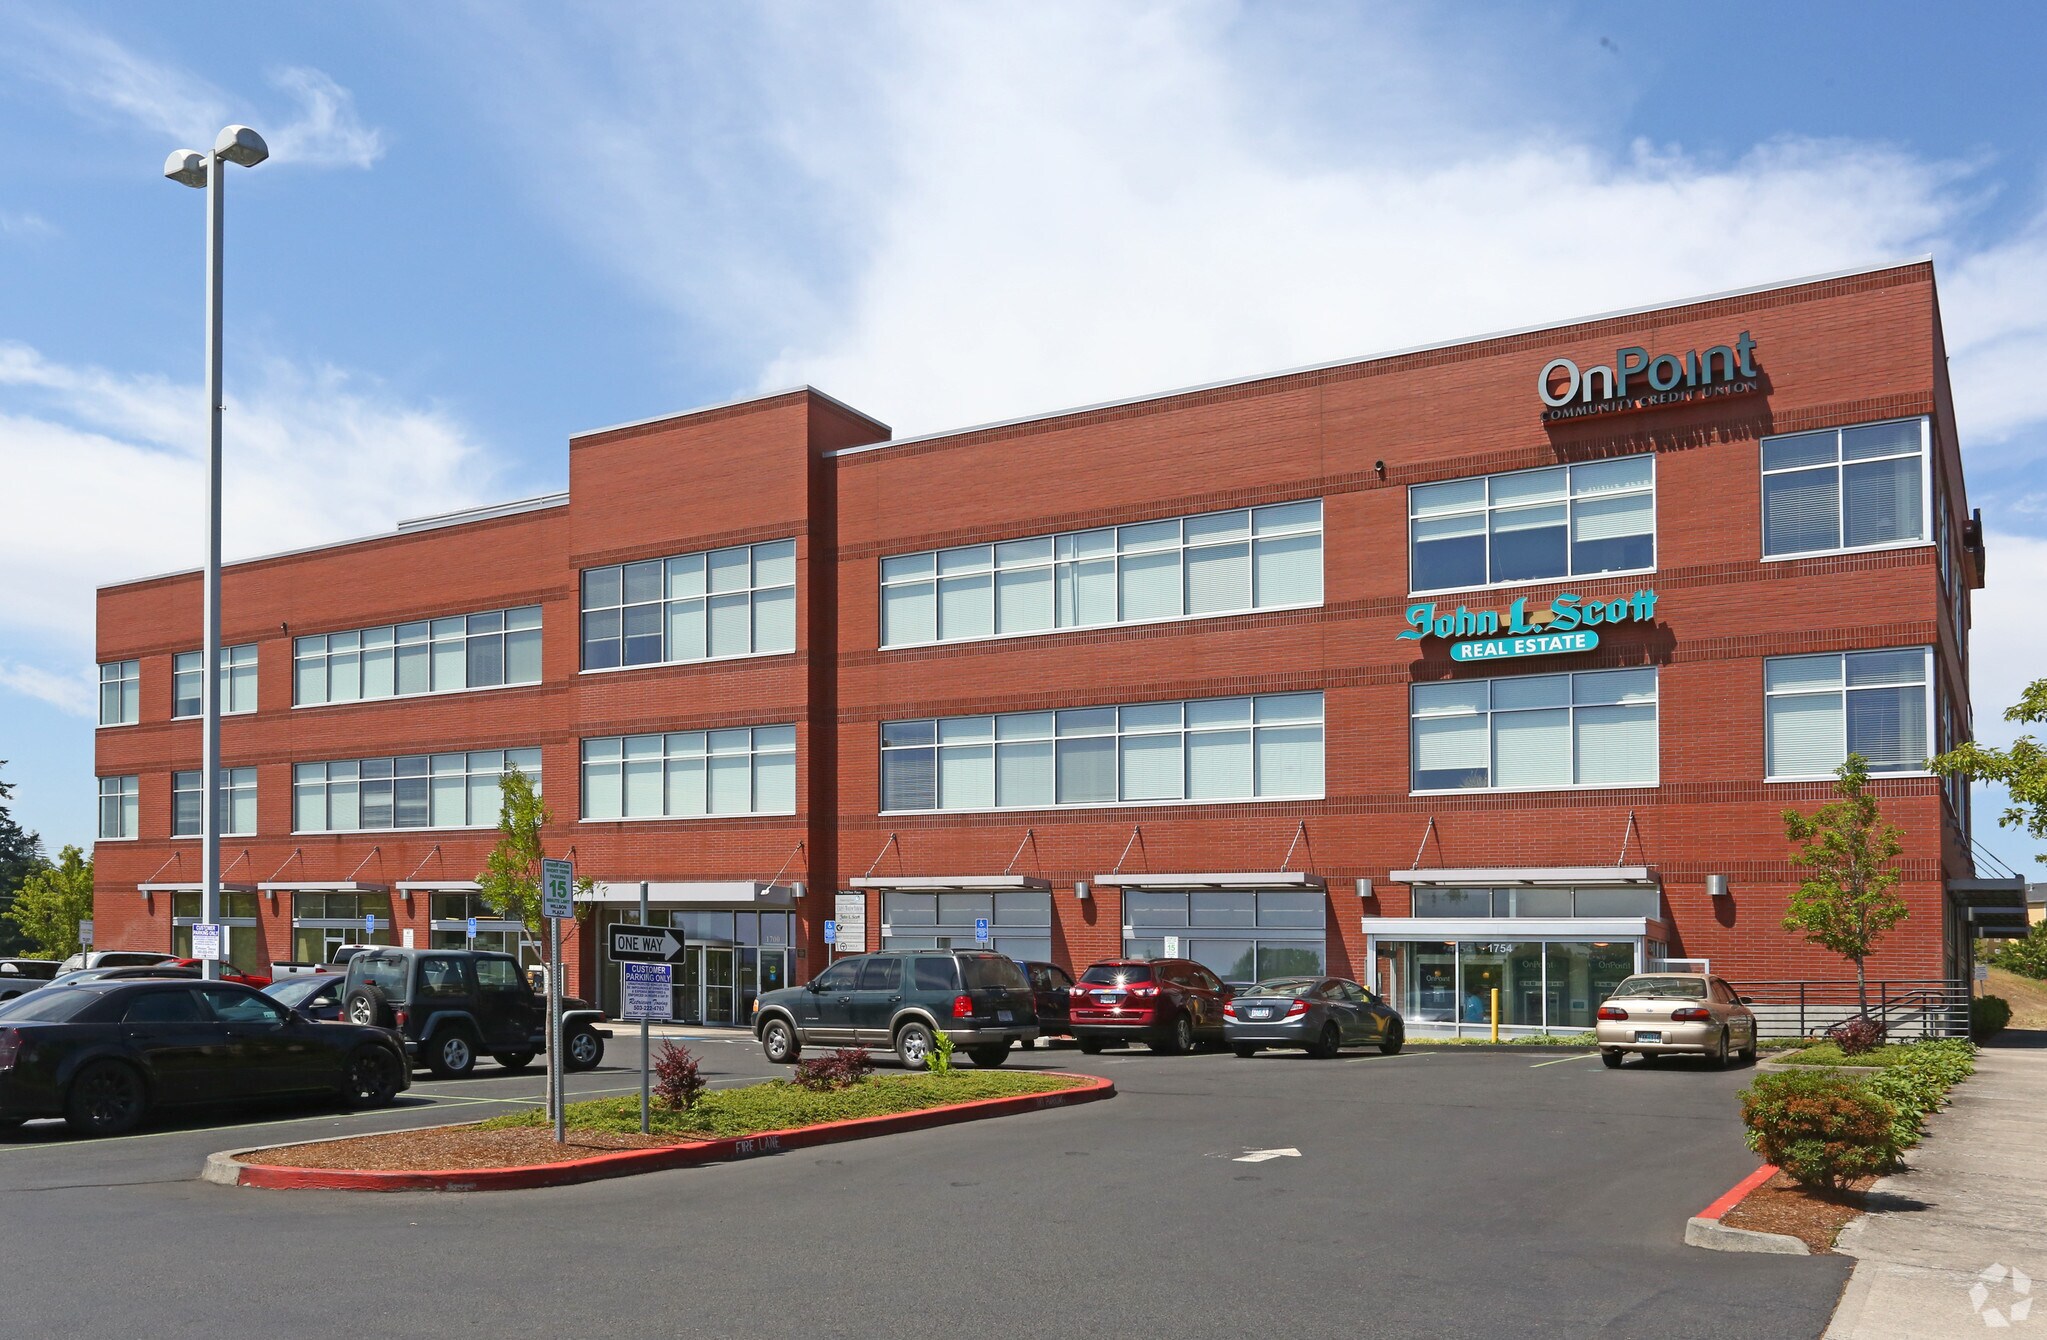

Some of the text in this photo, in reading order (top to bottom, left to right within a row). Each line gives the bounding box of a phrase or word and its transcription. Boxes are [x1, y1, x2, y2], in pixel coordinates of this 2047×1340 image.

[1537, 330, 1757, 407] OnPoint
[1540, 381, 1758, 422] COMMUNITY CREDIT UNION
[1395, 588, 1659, 641] John L. Scott
[1461, 633, 1586, 658] REAL ESTATE
[549, 880, 567, 898] 15
[618, 936, 663, 952] ONE WAY
[1488, 944, 1512, 952] 1754
[632, 965, 666, 974] CUSTOMER
[1599, 961, 1630, 969] OnPoint
[626, 973, 670, 983] PARKING ONLY
[653, 999, 668, 1007] Towing
[735, 1135, 780, 1154] FIRE LANE
